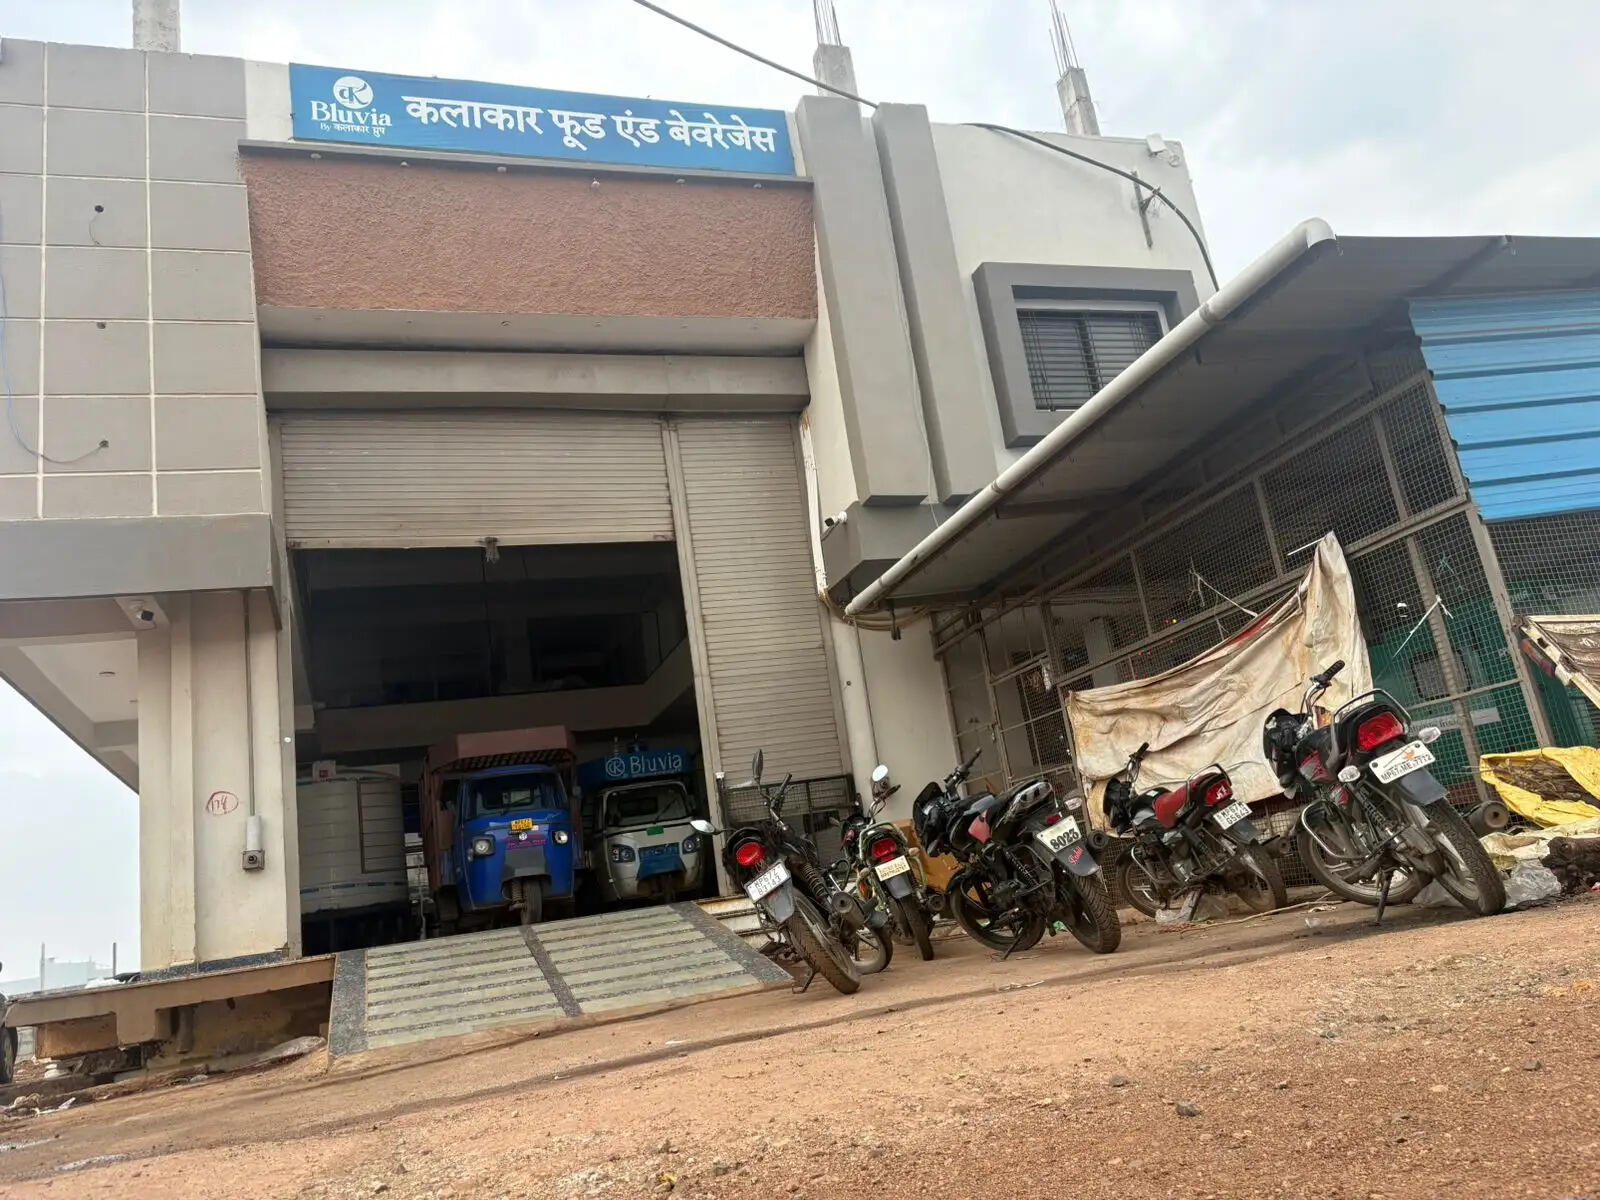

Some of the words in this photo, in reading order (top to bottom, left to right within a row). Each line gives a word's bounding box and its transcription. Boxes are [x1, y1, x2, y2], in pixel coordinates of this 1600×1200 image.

[310, 100, 392, 126] Bluvia
[401, 96, 544, 135] कलाकार
[548, 109, 607, 151] फूड
[611, 109, 661, 148] एंड
[664, 109, 777, 152] बेवरेजेस
[320, 122, 332, 132] By
[334, 122, 370, 134] कलाकार
[630, 752, 682, 774] Bluvia
